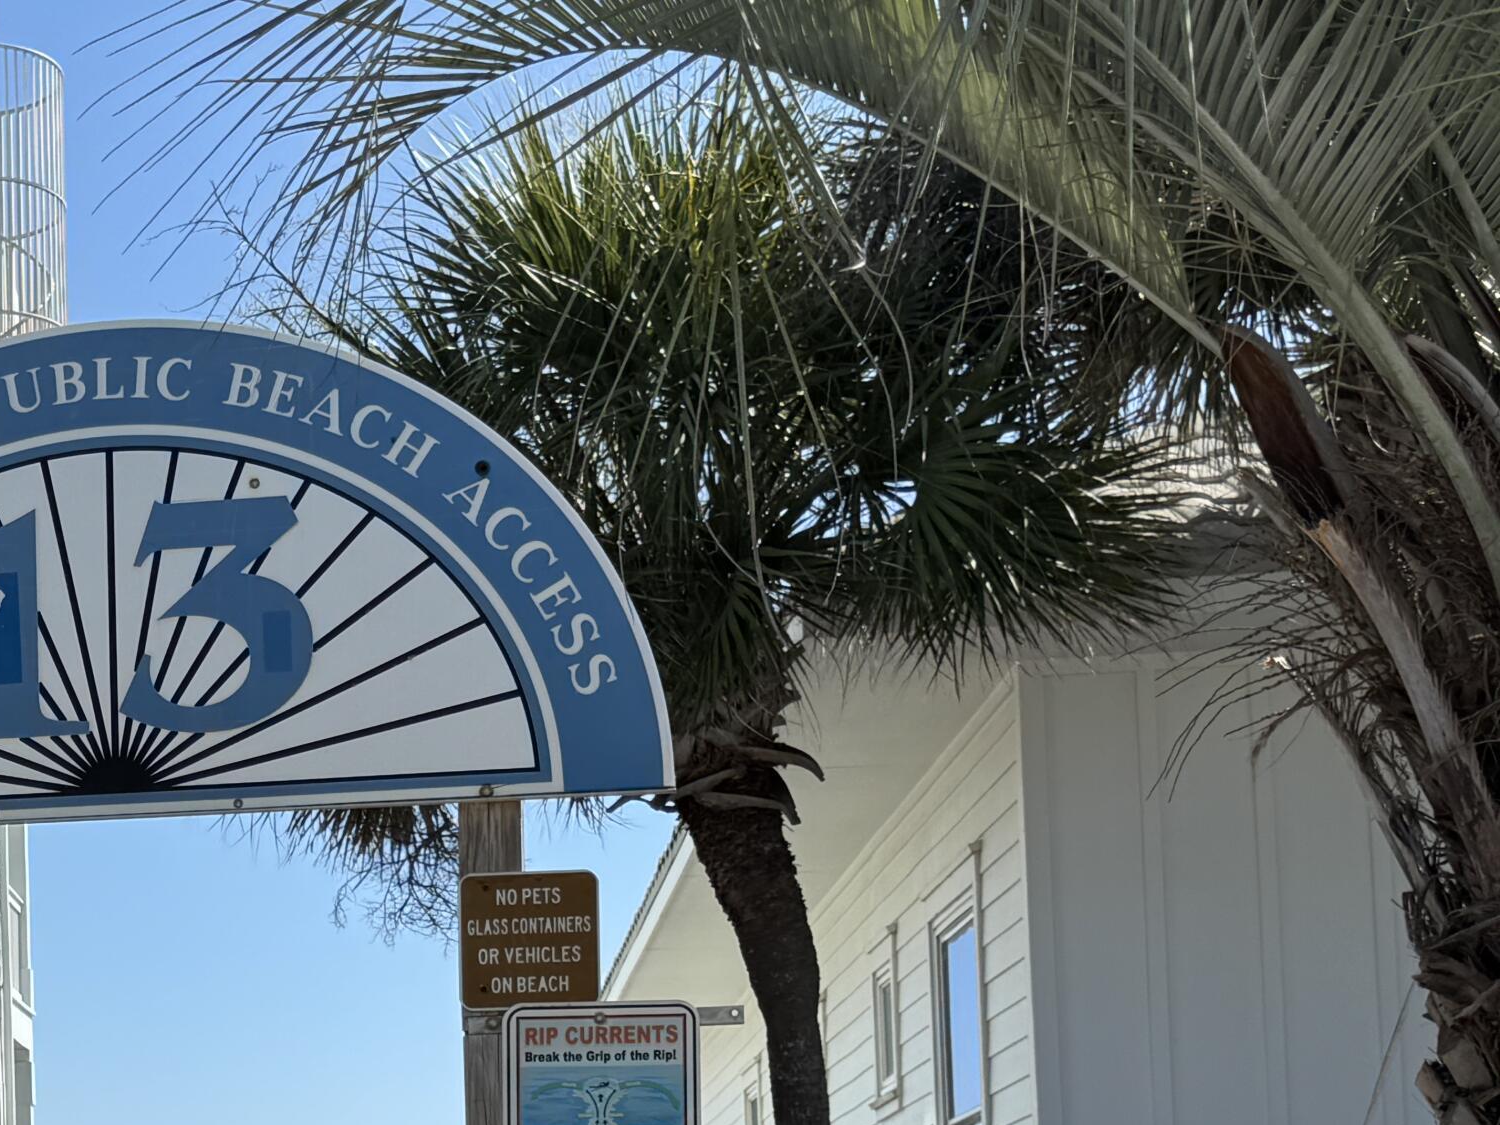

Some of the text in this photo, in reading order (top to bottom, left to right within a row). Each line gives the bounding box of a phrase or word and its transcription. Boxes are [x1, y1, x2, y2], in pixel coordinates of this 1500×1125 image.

[222, 362, 440, 479] BEACH
[442, 477, 618, 696] ACCESS
[496, 887, 561, 906] NO PETS
[467, 915, 591, 936] GLASS CONTAINERS
[478, 945, 581, 965] OR VEHICLES
[491, 975, 569, 993] ON BEACH
[525, 1024, 678, 1046] RIP CURRENTS
[525, 1049, 677, 1064] Break the Grip of the Rip!
